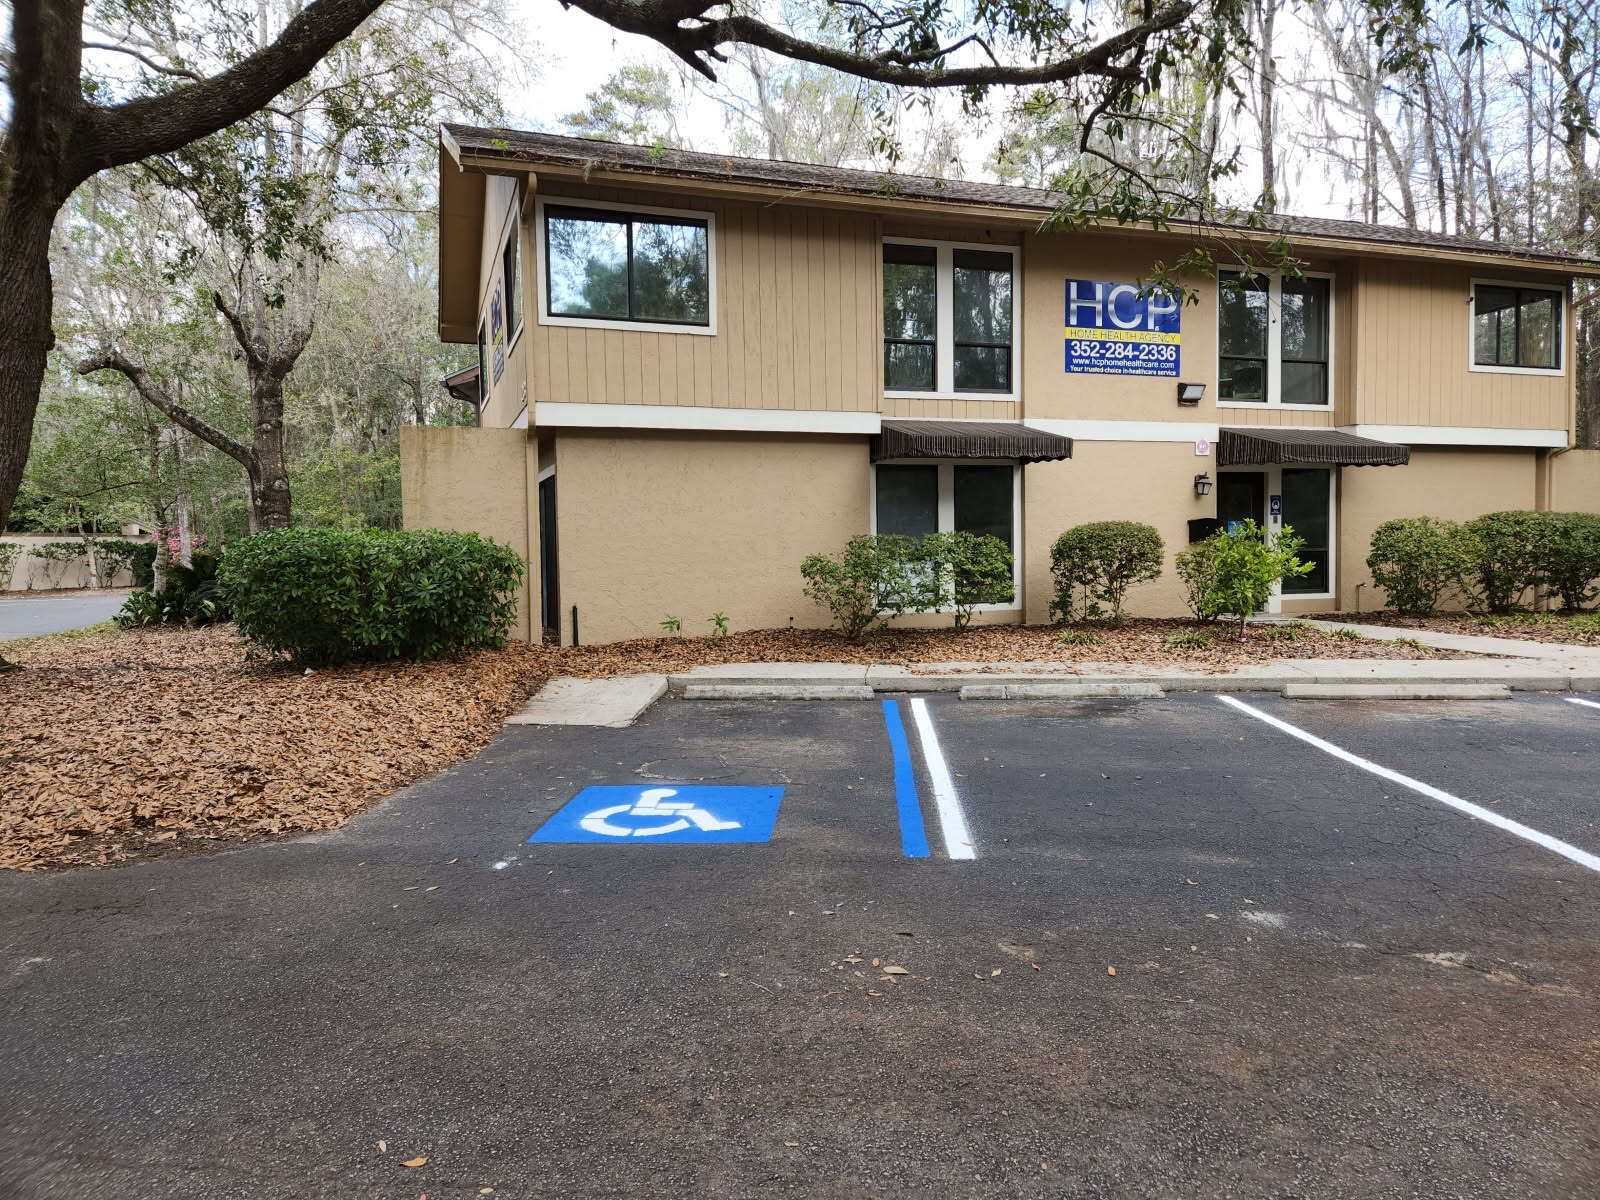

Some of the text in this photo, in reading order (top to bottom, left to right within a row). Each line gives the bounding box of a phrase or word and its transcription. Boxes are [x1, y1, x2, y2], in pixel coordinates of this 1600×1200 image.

[1070, 281, 1177, 330] HCP
[1070, 329, 1176, 343] HOME HEALTH AGENCY
[1070, 341, 1176, 361] 352-284-2336
[1072, 357, 1174, 369] www.hcphomehealthcare.com
